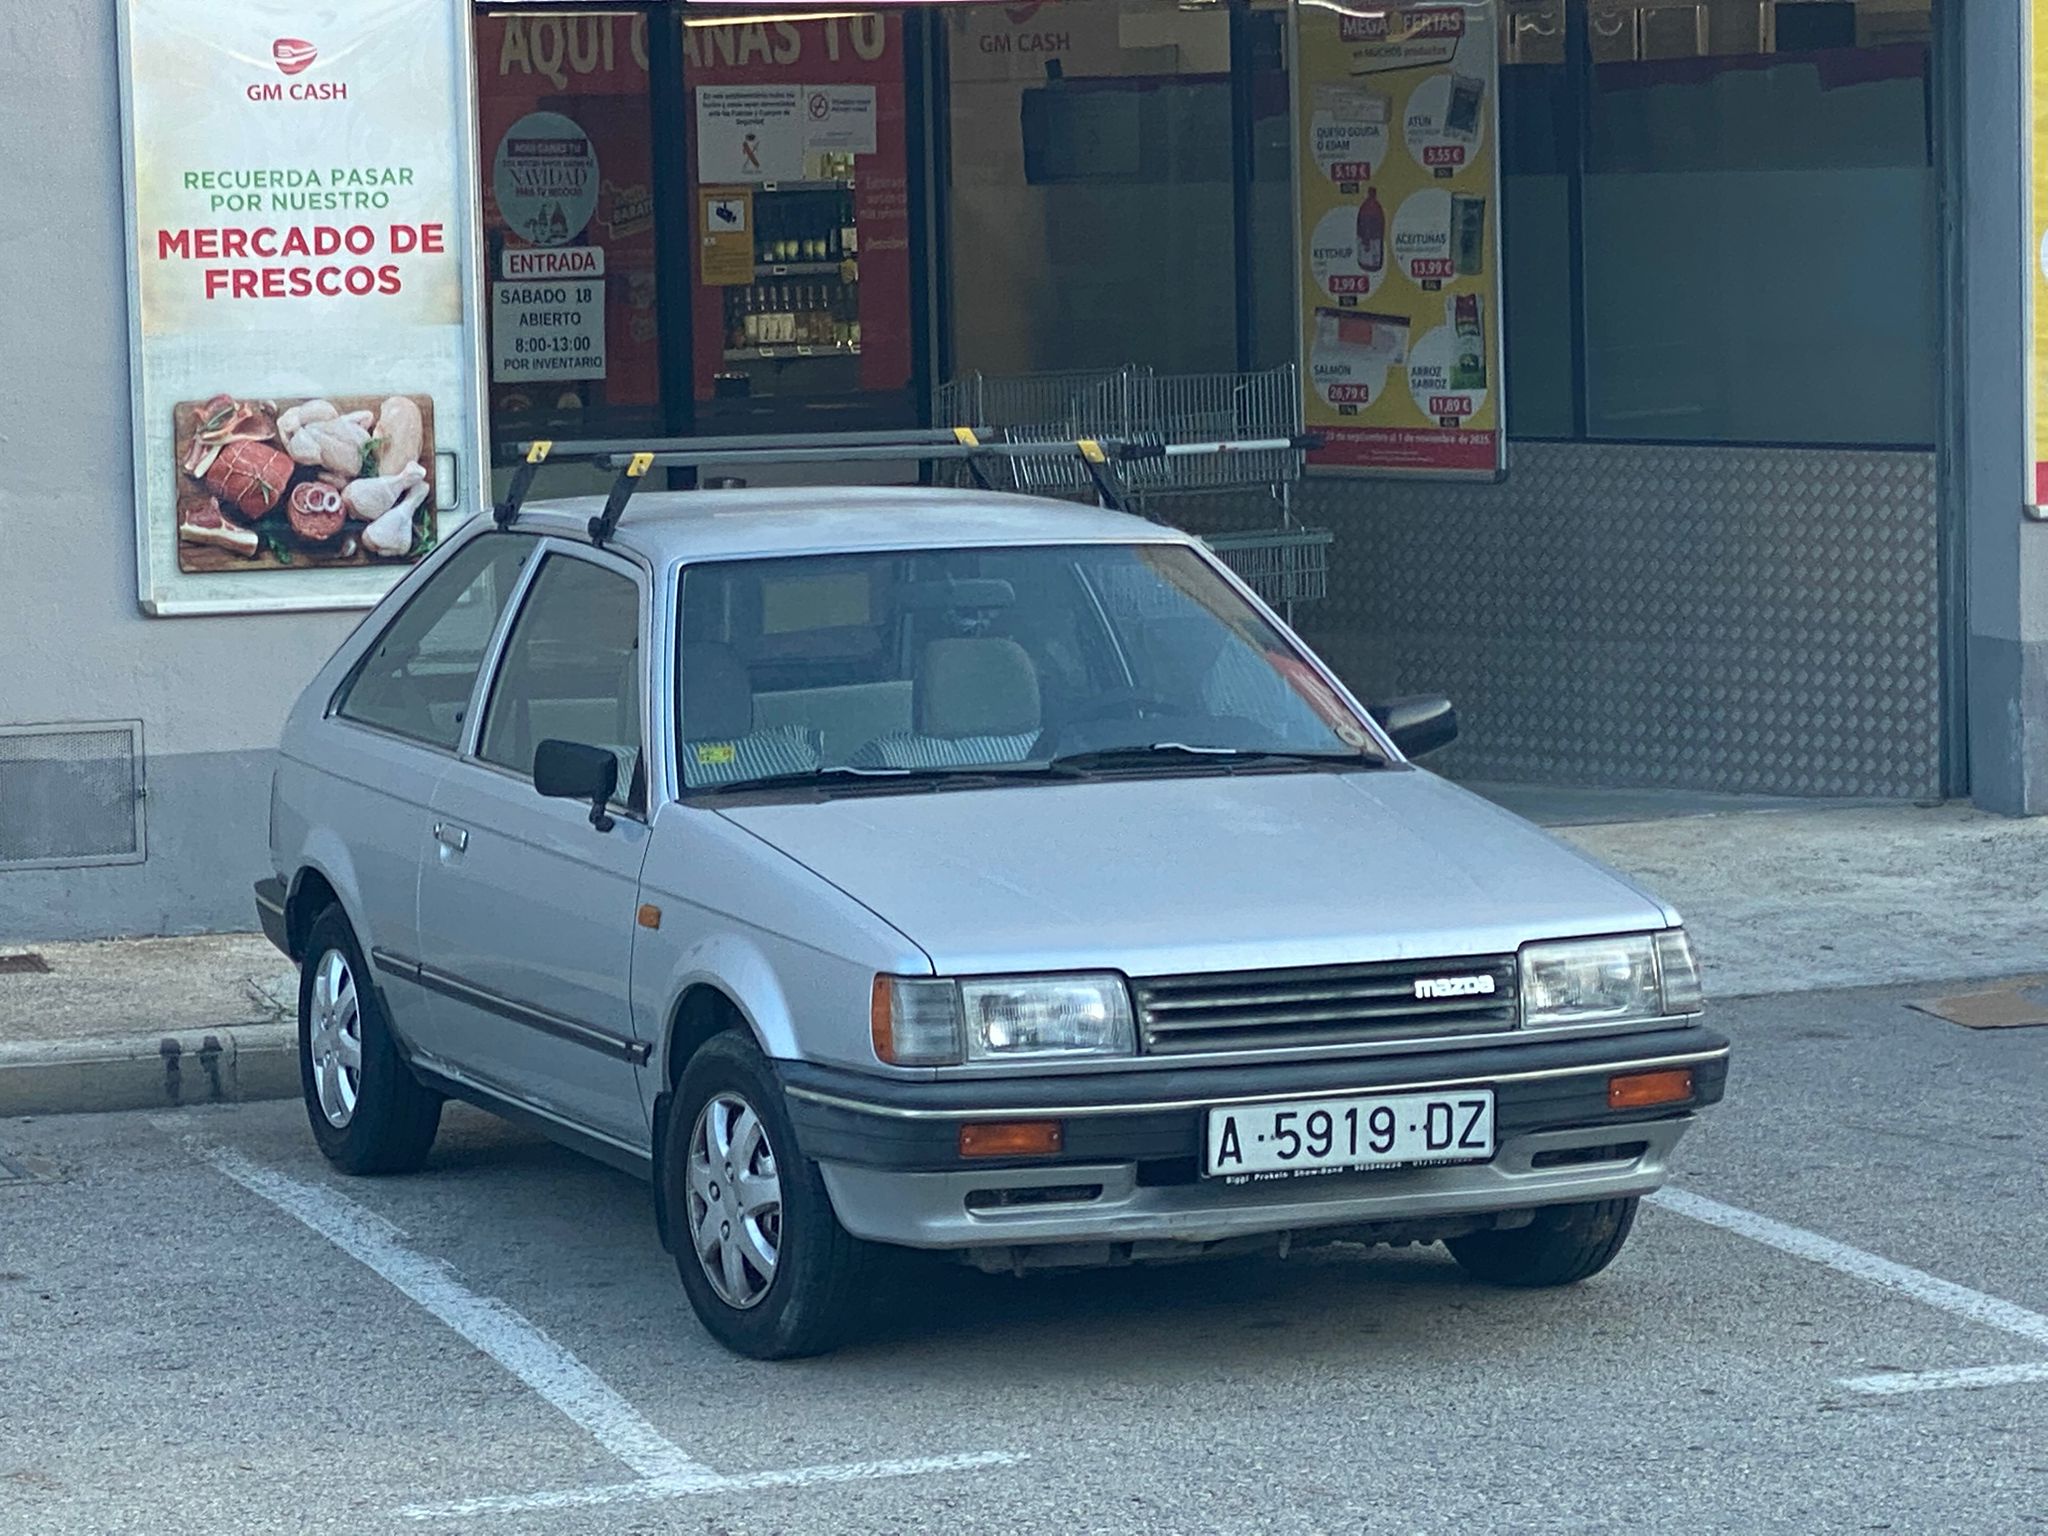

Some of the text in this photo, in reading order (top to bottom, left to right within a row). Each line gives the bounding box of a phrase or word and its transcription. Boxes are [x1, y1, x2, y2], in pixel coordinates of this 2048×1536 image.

[1342, 17, 1388, 36] MEGA
[980, 31, 1070, 53] GM CASH
[247, 83, 347, 101] GM CASH
[184, 168, 414, 189] RECUERDA PASAR
[509, 168, 587, 185] NAVIDAD
[211, 191, 389, 212] POR NUESTRO
[158, 223, 445, 260] MERCADO DE
[510, 252, 596, 273] ENTRADA
[205, 265, 402, 299] FRESCOS
[500, 288, 592, 304] SABADO 18
[519, 312, 581, 326] ABIERTO
[515, 336, 590, 352] 8:00-13:00
[504, 356, 602, 370] POR INVENTARIO
